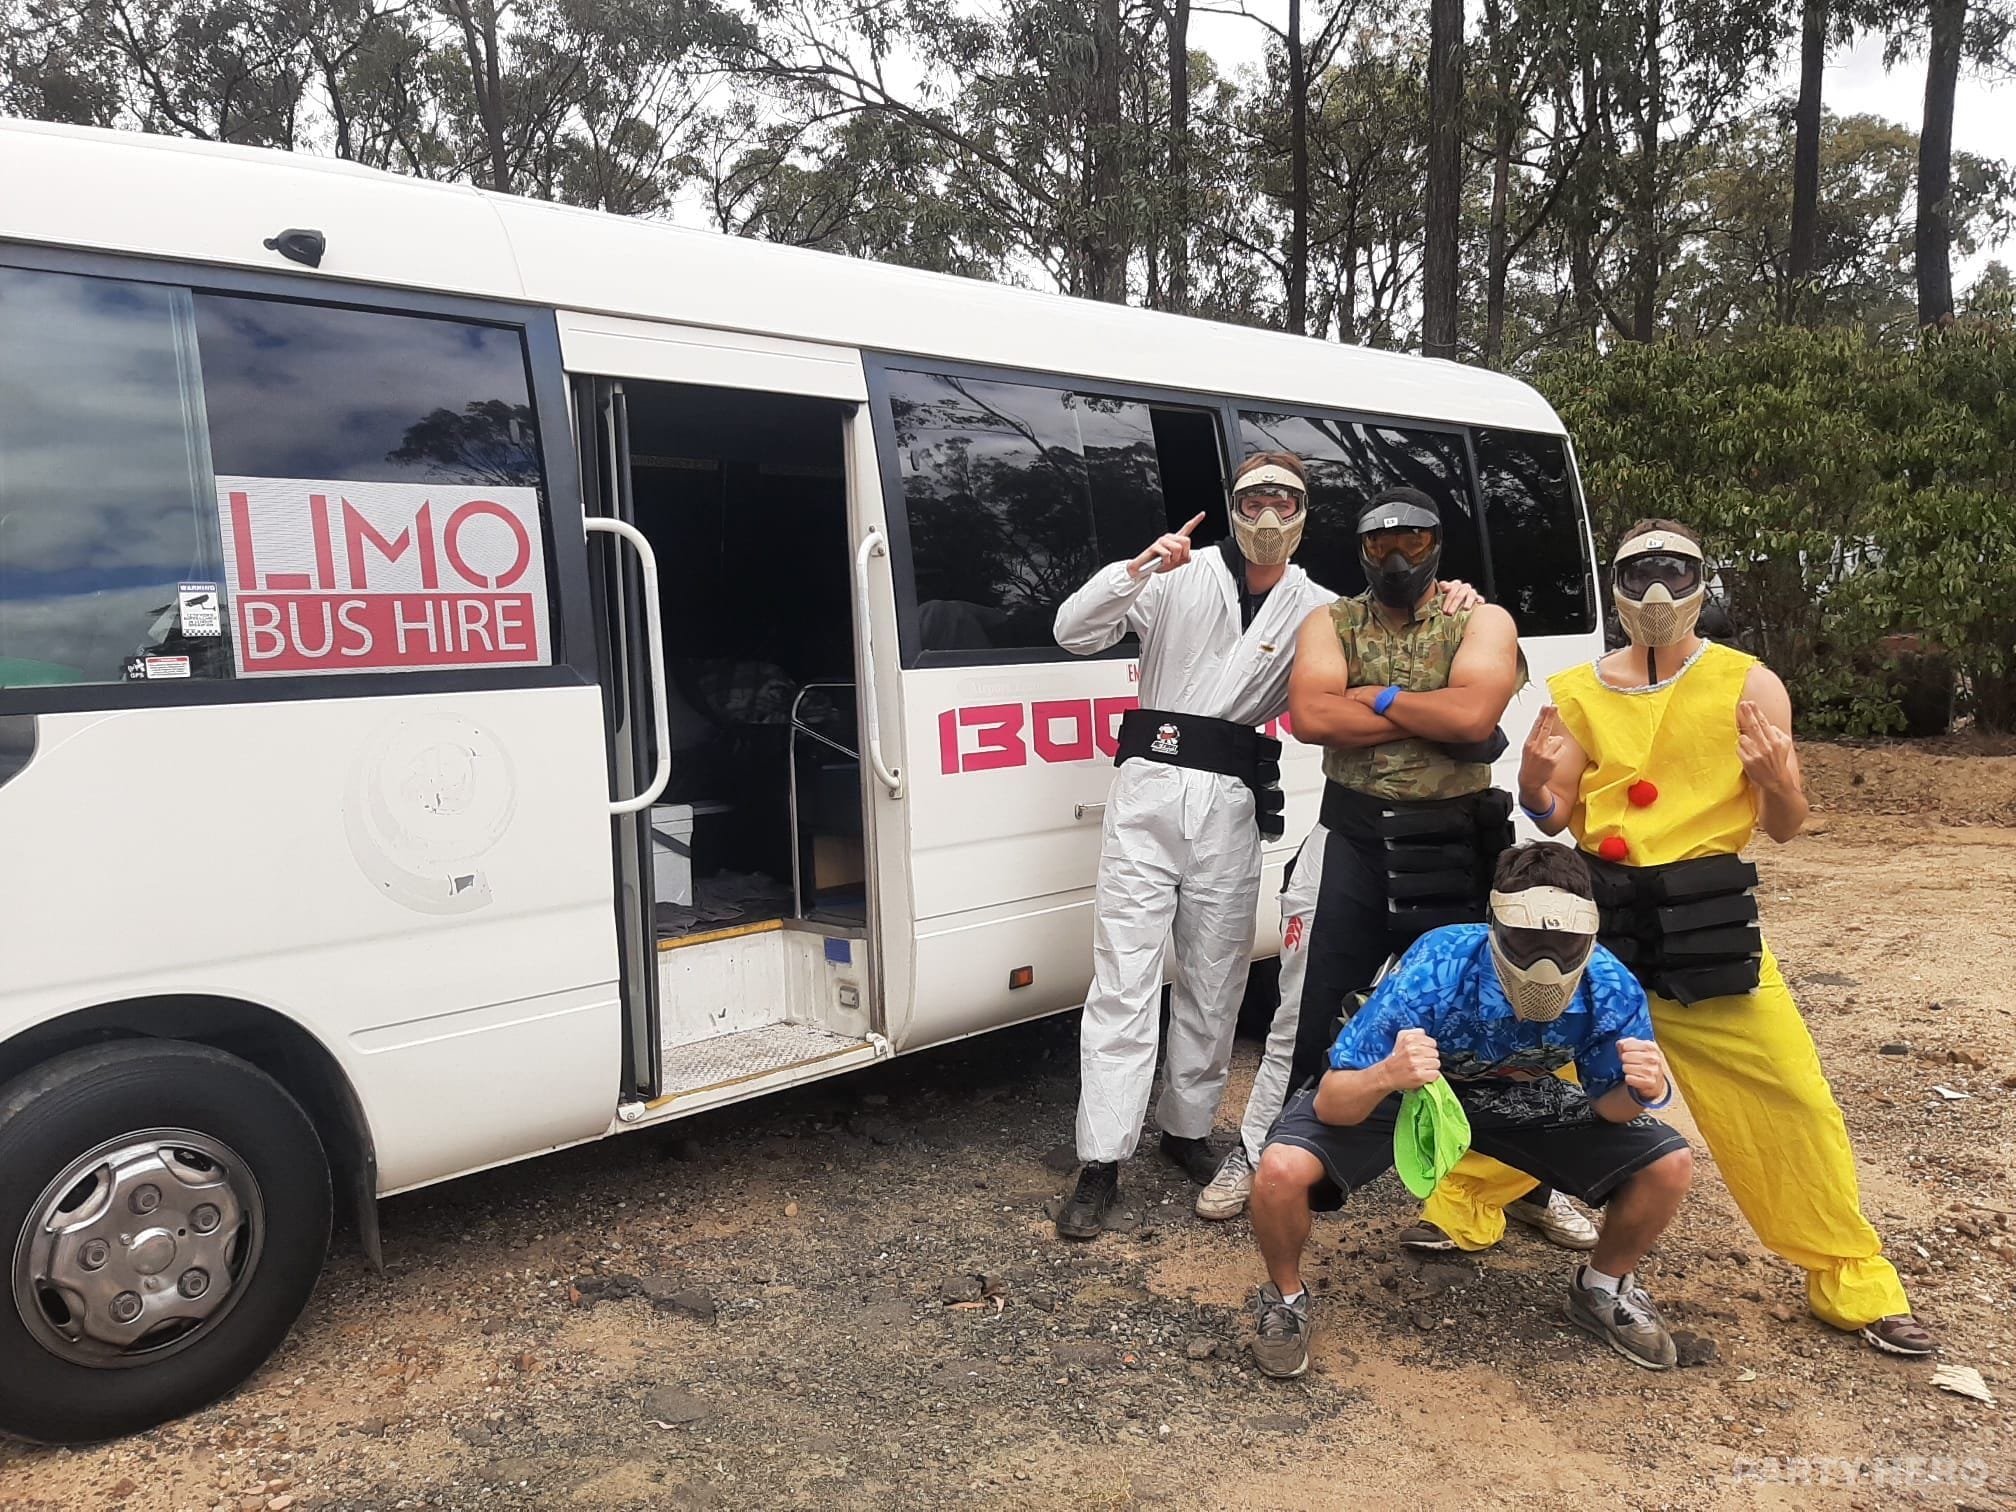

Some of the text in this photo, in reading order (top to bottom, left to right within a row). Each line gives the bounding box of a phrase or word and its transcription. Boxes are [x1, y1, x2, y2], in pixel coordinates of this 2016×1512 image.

[229, 491, 531, 590] LIMO
[244, 599, 528, 660] BUS HIRE
[938, 696, 1140, 775] 1300
